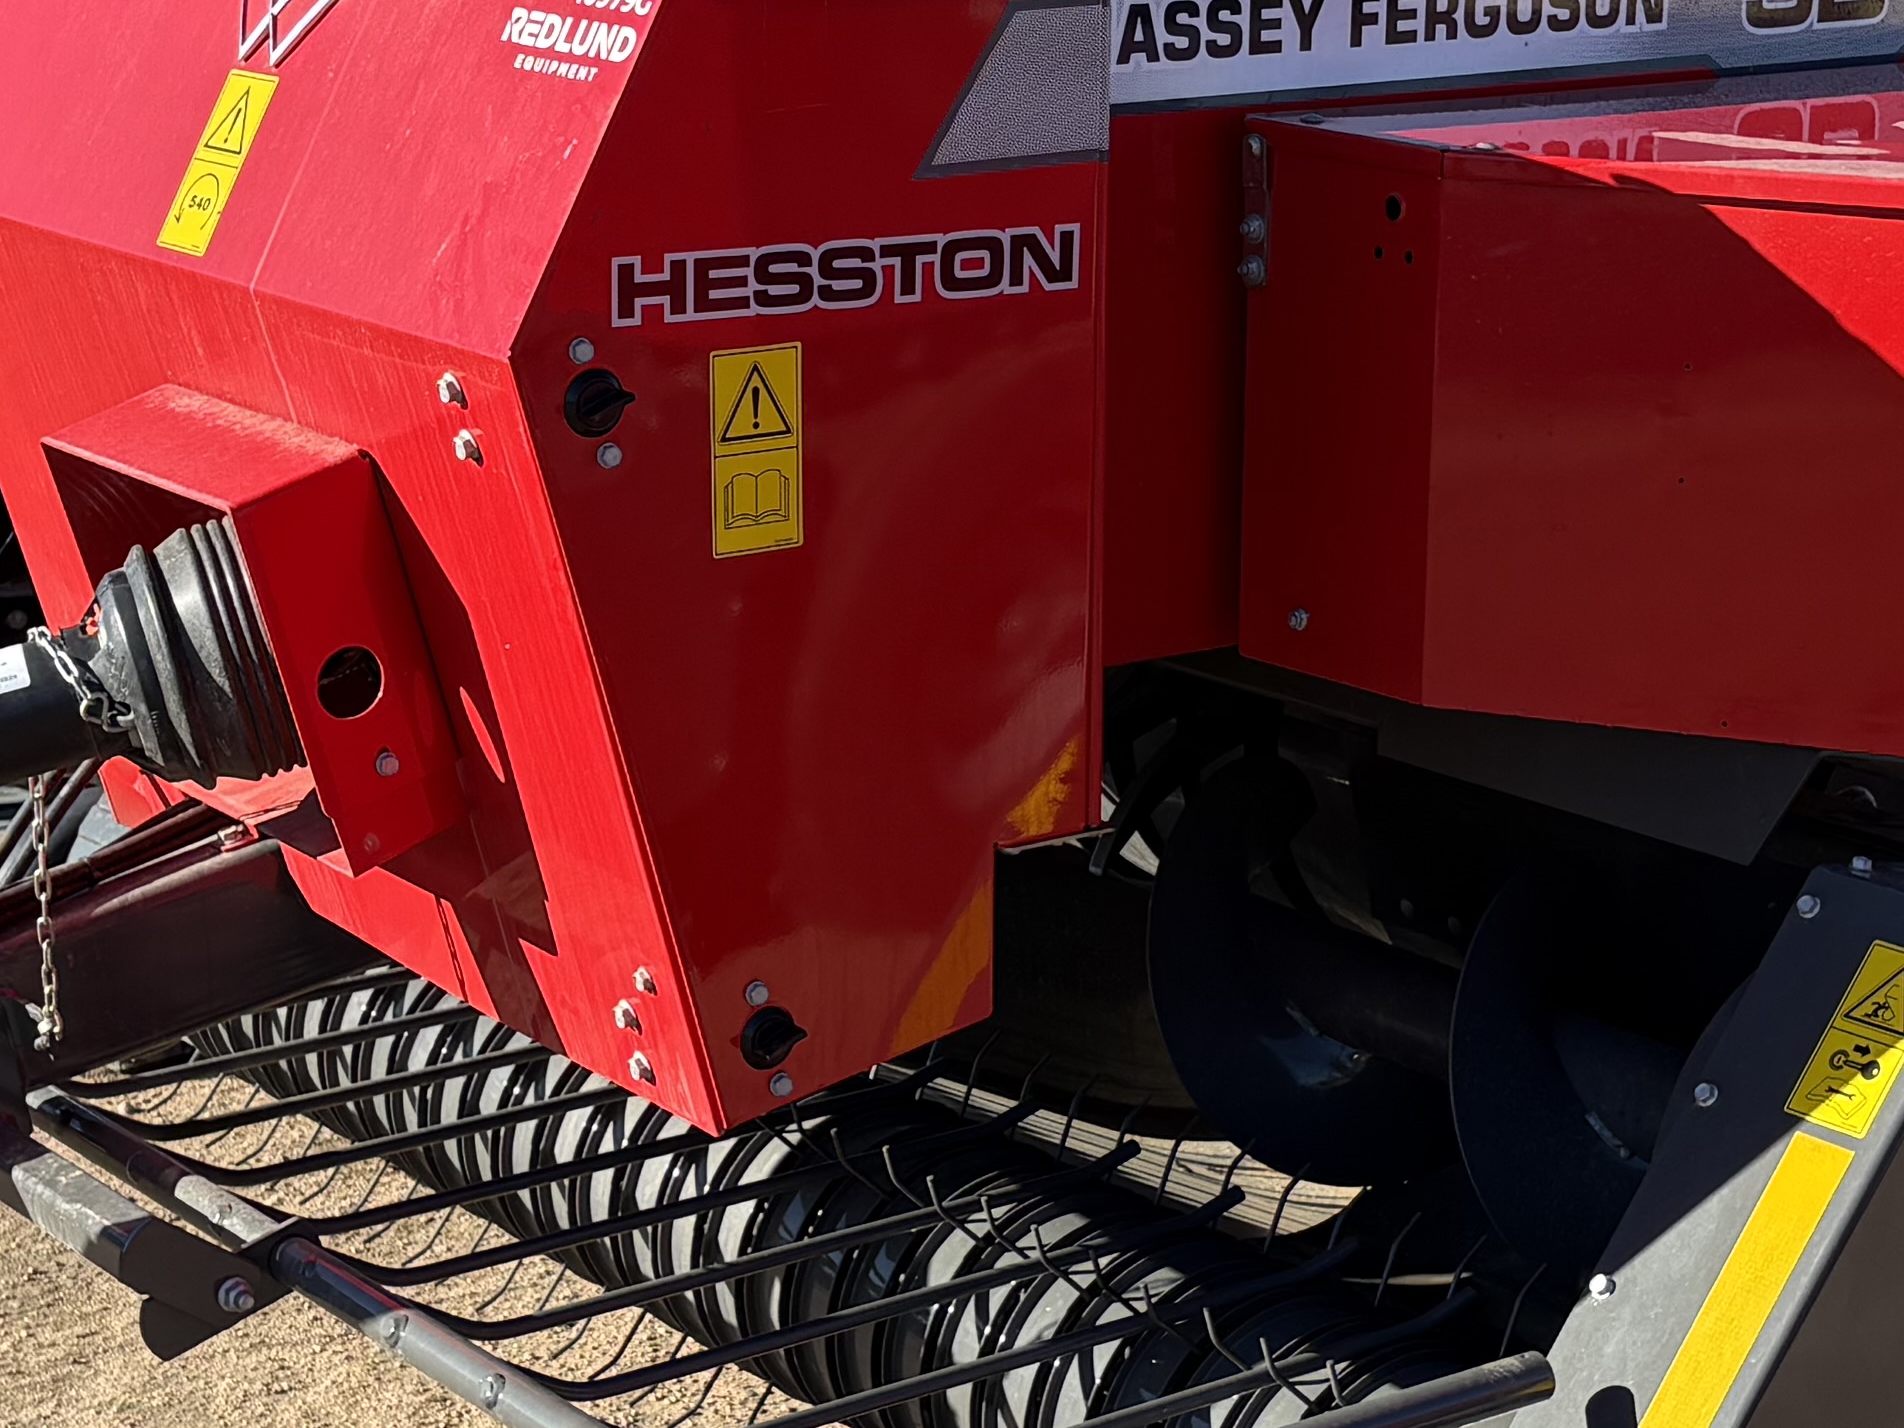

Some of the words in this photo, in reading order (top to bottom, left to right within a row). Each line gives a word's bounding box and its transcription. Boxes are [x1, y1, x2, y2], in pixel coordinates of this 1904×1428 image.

[500, 6, 637, 63] REDLUND
[513, 53, 599, 82] EQUIPMENT
[188, 194, 211, 212] 540
[611, 222, 1081, 328] HESSTON
